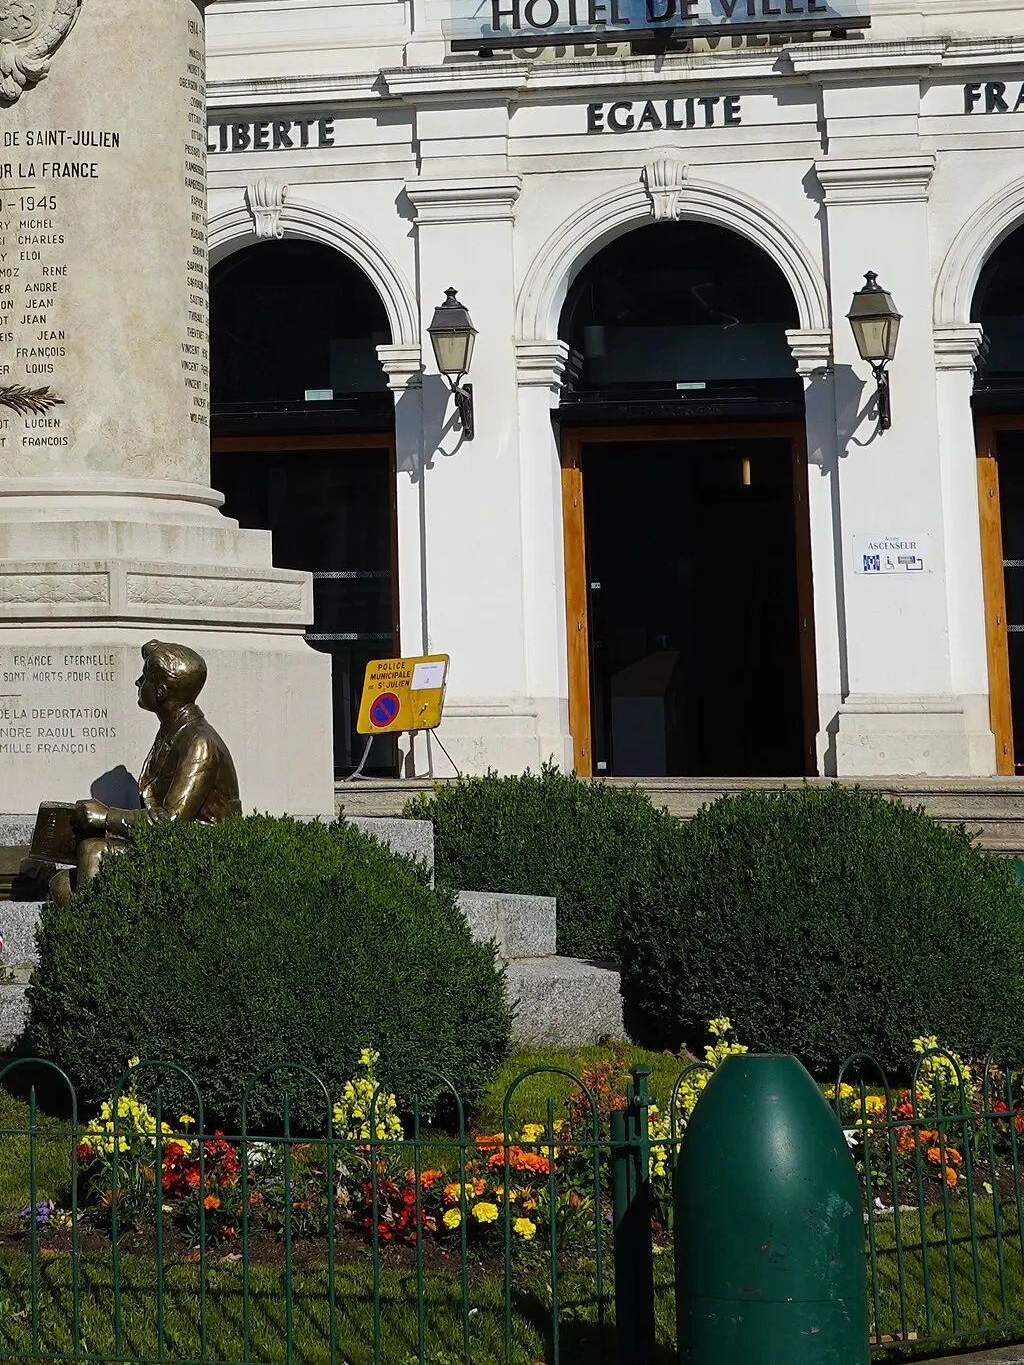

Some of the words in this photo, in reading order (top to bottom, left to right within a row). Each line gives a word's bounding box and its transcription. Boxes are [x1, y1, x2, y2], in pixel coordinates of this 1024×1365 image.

[587, 95, 742, 132] EGALITE
[4, 131, 20, 147] DE
[26, 130, 120, 148] SAINT-JULIEN
[19, 163, 36, 178] LA
[42, 162, 99, 178] FRANCE
[19, 219, 53, 229] MICHEL
[18, 234, 65, 245] CHARLES
[20, 251, 40, 260] ELOI
[42, 264, 68, 276] RENÉ
[25, 282, 57, 292] ANDRE
[25, 299, 53, 309] JEAN
[20, 315, 46, 324] JEAN
[37, 331, 65, 340] JEAN
[16, 347, 66, 358] FRANÇOIS
[25, 364, 53, 373] LOUIS
[25, 418, 60, 428] LUCIEN
[868, 542, 916, 550] ASCENSEUR
[14, 655, 52, 666] FRANCE
[64, 654, 115, 666] ETERNELLE
[378, 662, 405, 671] POLICE
[3, 671, 26, 682] SONT
[33, 671, 63, 682] MORTS
[68, 671, 90, 682] POUR
[96, 671, 115, 682] ELLE
[370, 671, 410, 681] MUNICIPALE
[386, 680, 409, 689] JULIEN
[13, 709, 27, 719] LA
[32, 708, 108, 719] DEPORTATION
[38, 727, 76, 737] RAOUL
[83, 727, 116, 737] BORIS
[37, 743, 96, 755] FRANÇOIS
